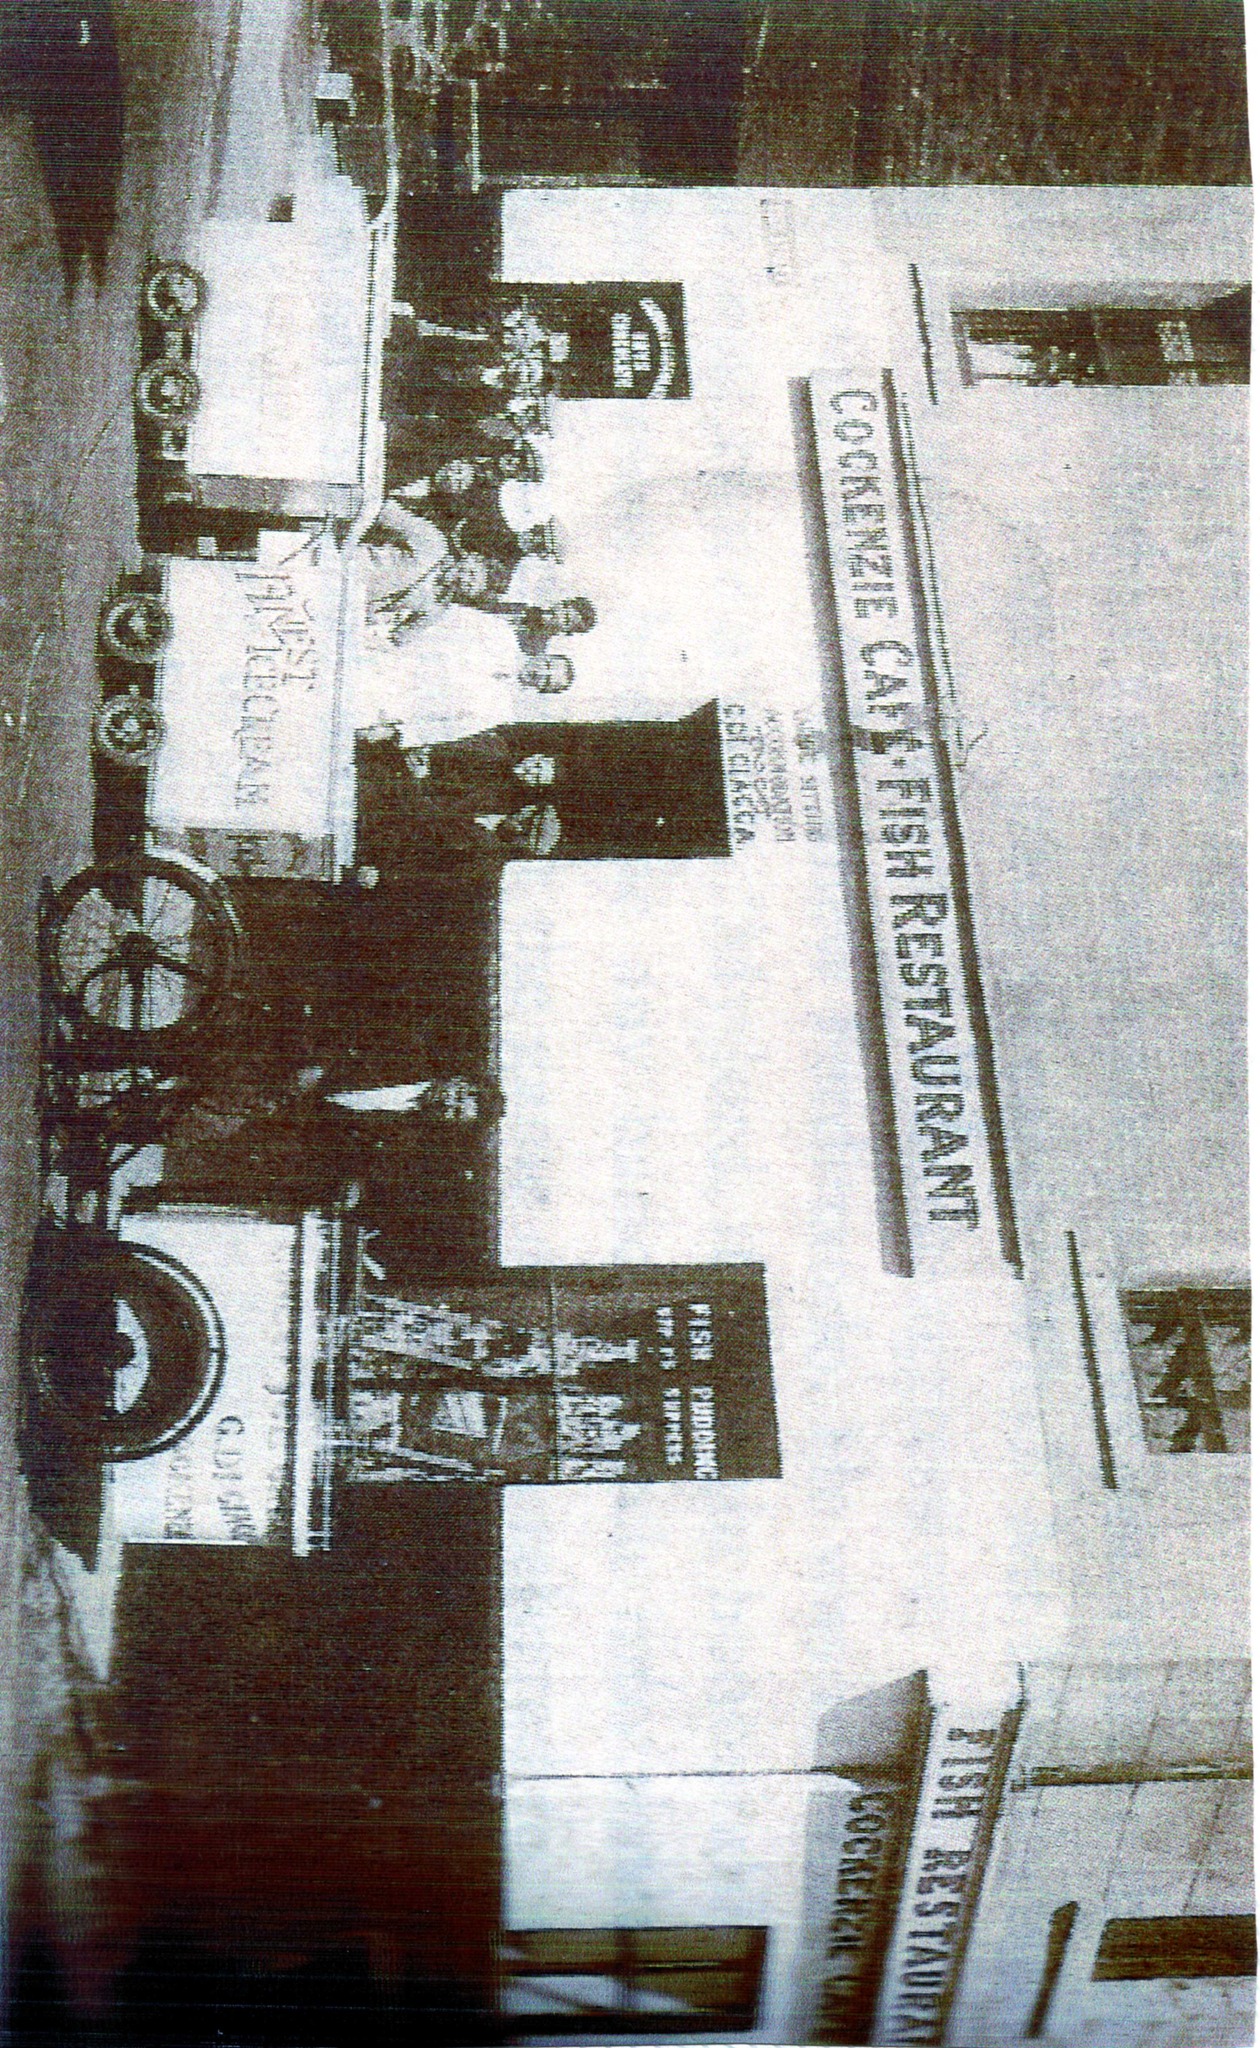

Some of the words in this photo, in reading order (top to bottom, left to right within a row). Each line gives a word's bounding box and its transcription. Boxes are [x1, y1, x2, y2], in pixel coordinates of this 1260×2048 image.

[829, 389, 900, 619] COCKENZIE
[876, 778, 934, 878] FISH
[889, 893, 980, 1231] RESTAURANT
[687, 1303, 714, 1361] FISH
[932, 1728, 998, 1820] FISH
